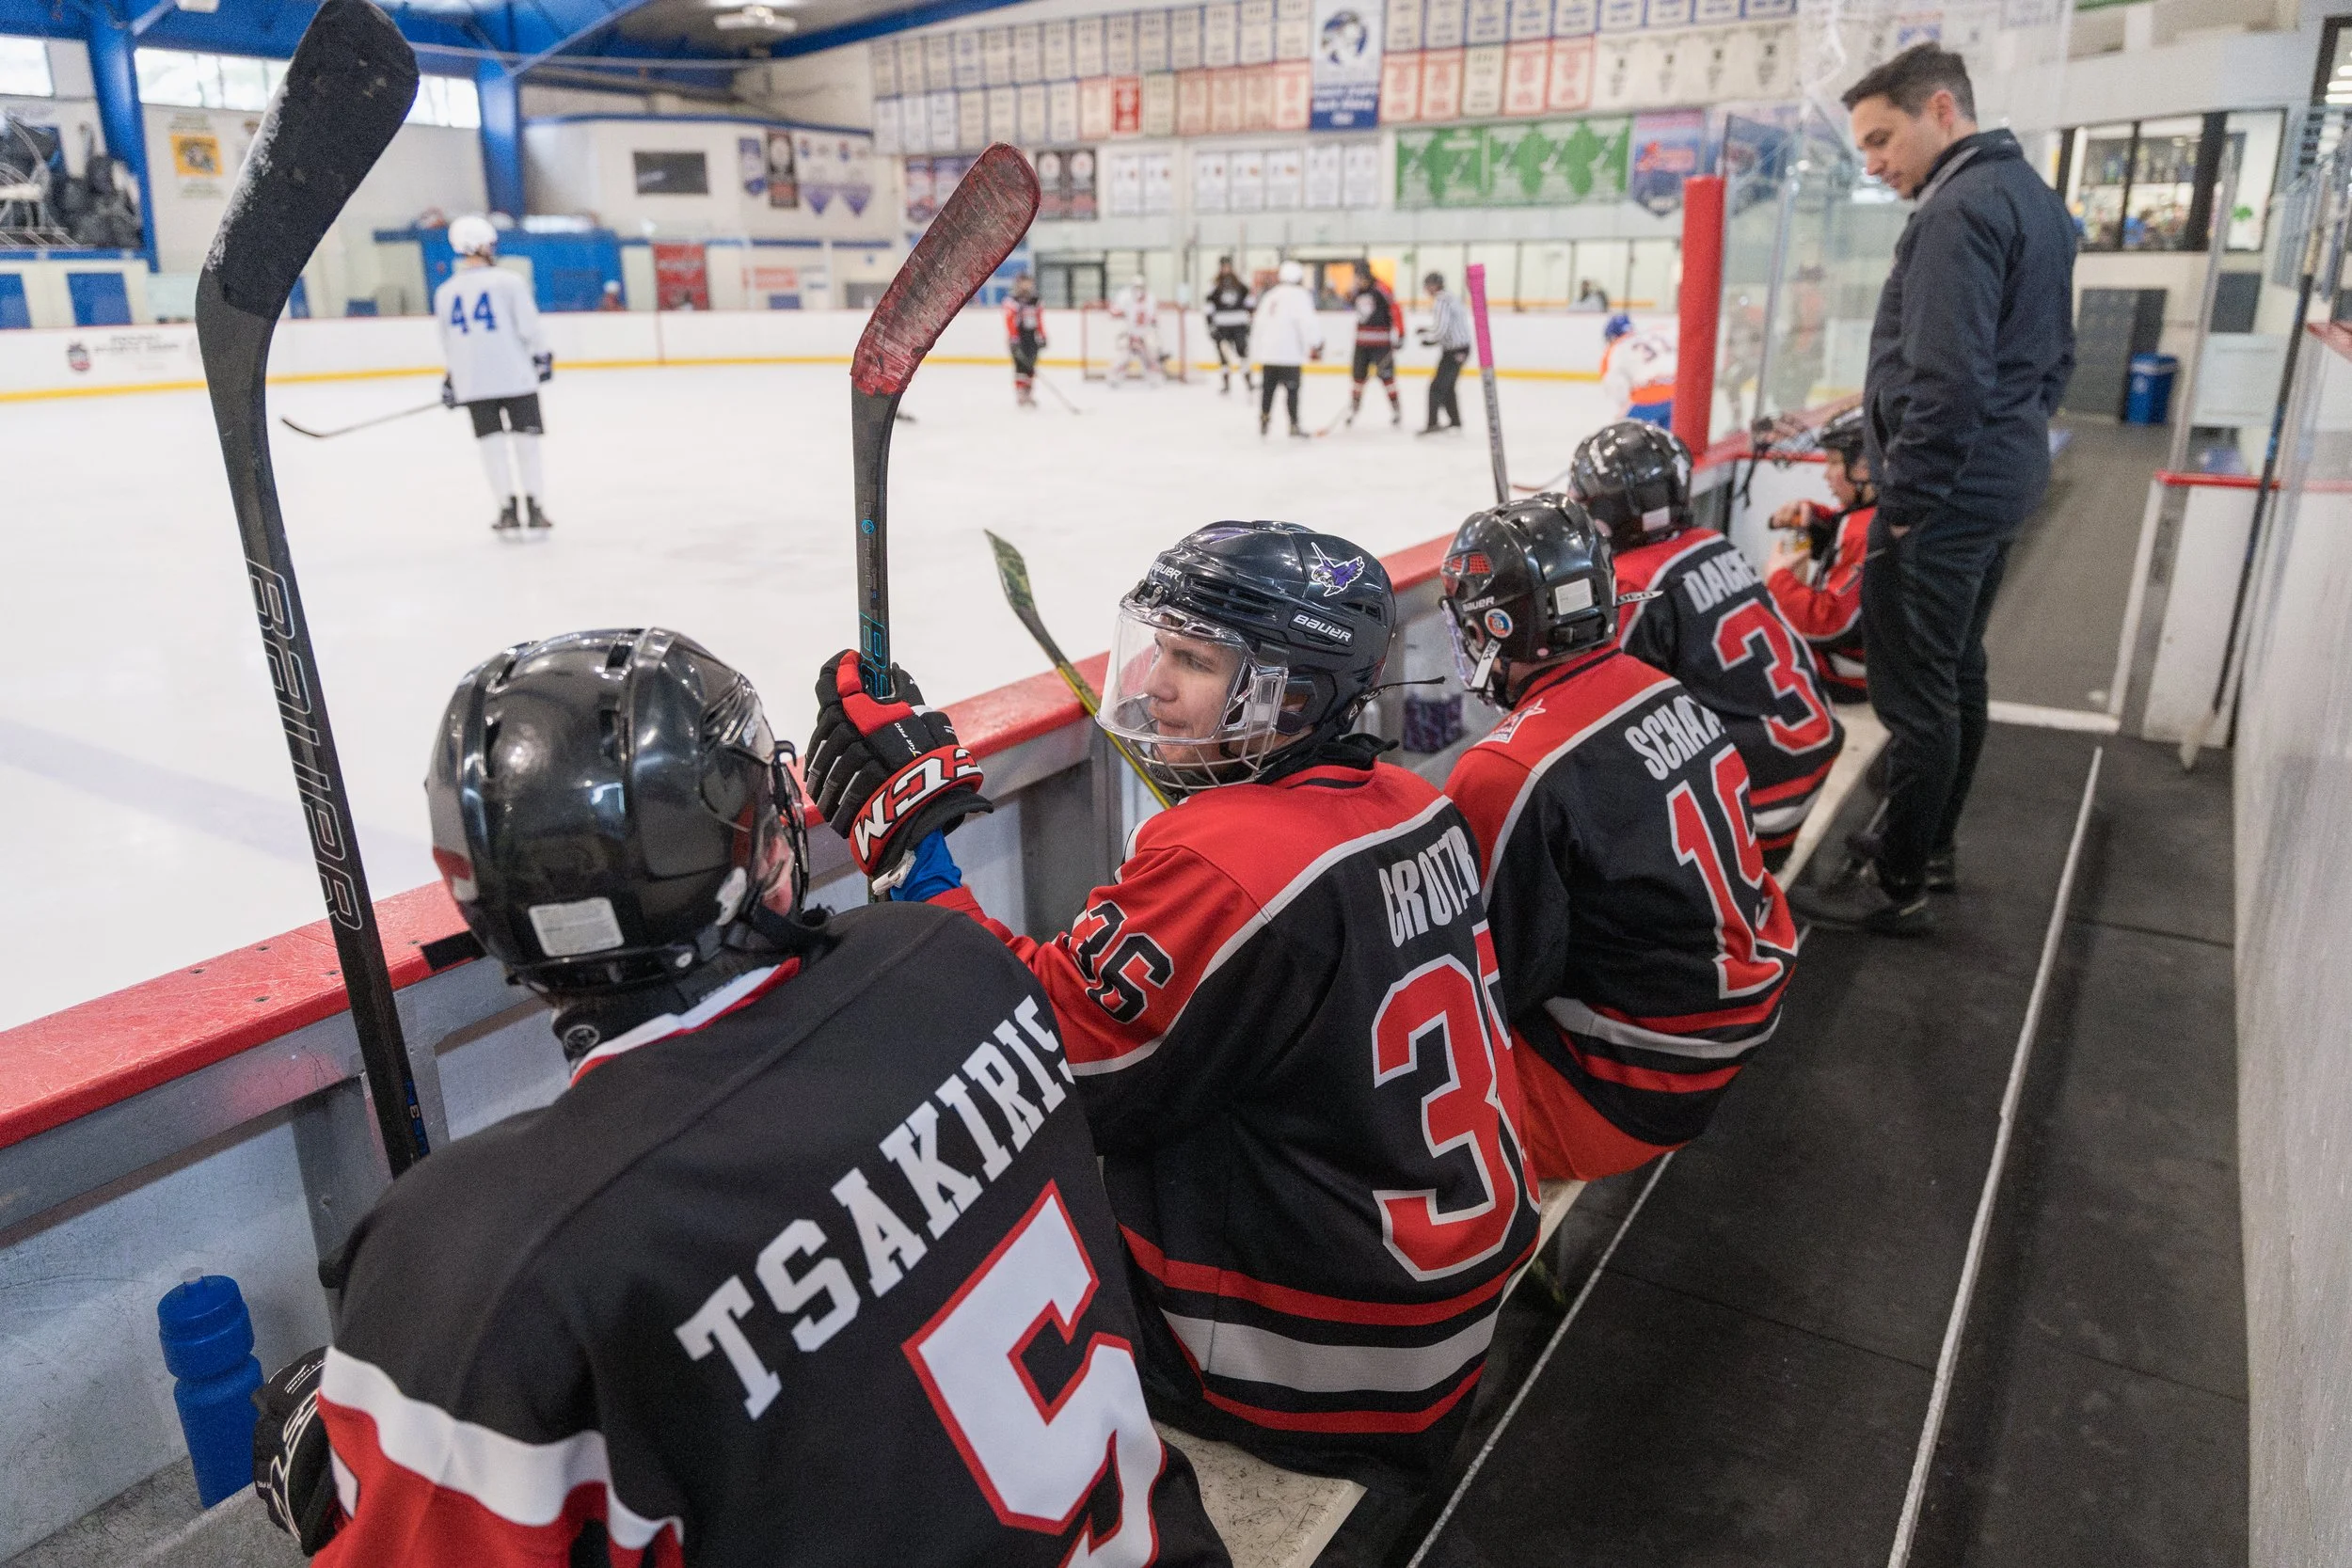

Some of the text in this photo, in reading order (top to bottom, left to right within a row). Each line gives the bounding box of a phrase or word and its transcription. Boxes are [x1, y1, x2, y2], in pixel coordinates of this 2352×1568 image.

[451, 292, 497, 334] 44
[1152, 562, 1183, 580] AUER
[1293, 613, 1353, 642] BAUER
[854, 748, 984, 863] CCM
[675, 994, 1074, 1420] TSAKIRIS
